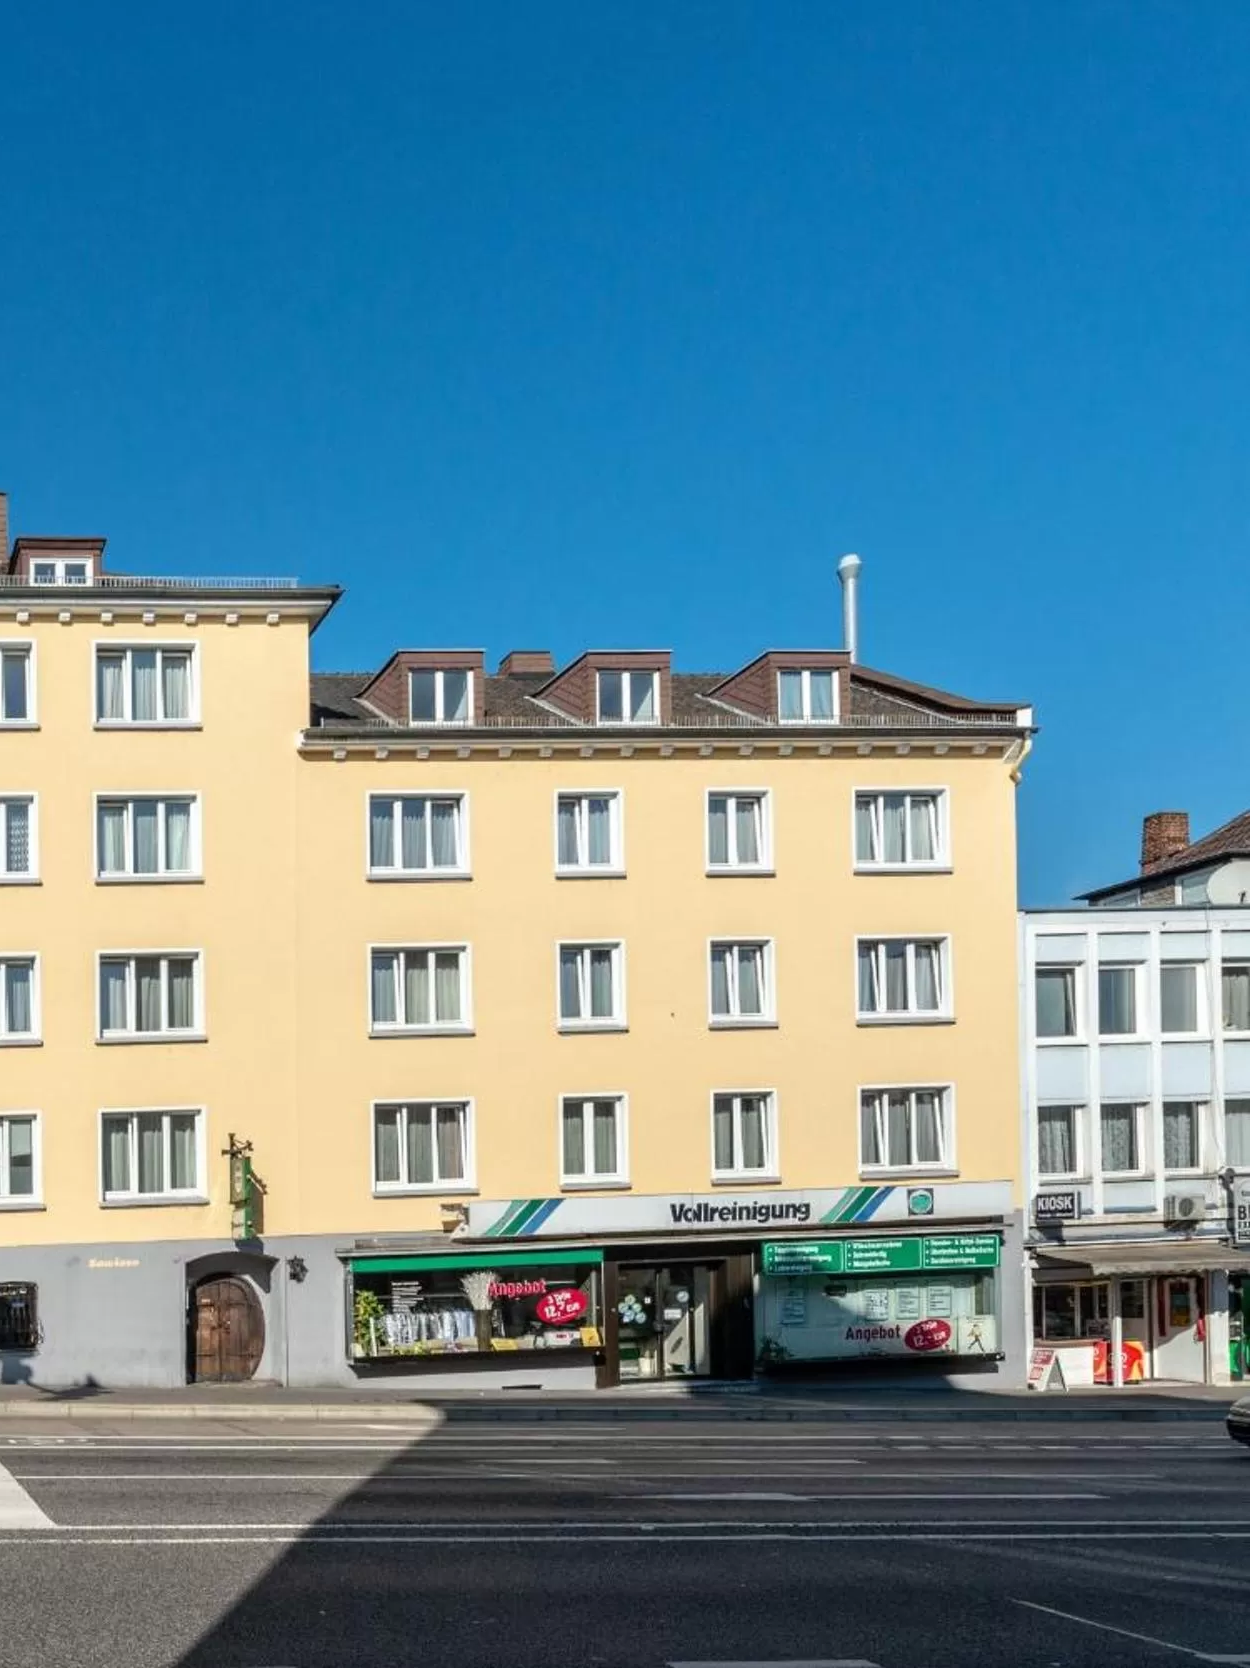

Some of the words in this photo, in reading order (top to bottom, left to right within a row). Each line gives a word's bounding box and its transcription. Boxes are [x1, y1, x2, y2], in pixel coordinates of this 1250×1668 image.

[670, 1202, 811, 1223] Vollreinigung
[1037, 1196, 1073, 1211] KIOSK
[1237, 1205, 1250, 1221] B
[488, 1279, 546, 1299] Angebot
[845, 1324, 901, 1342] Angebot
